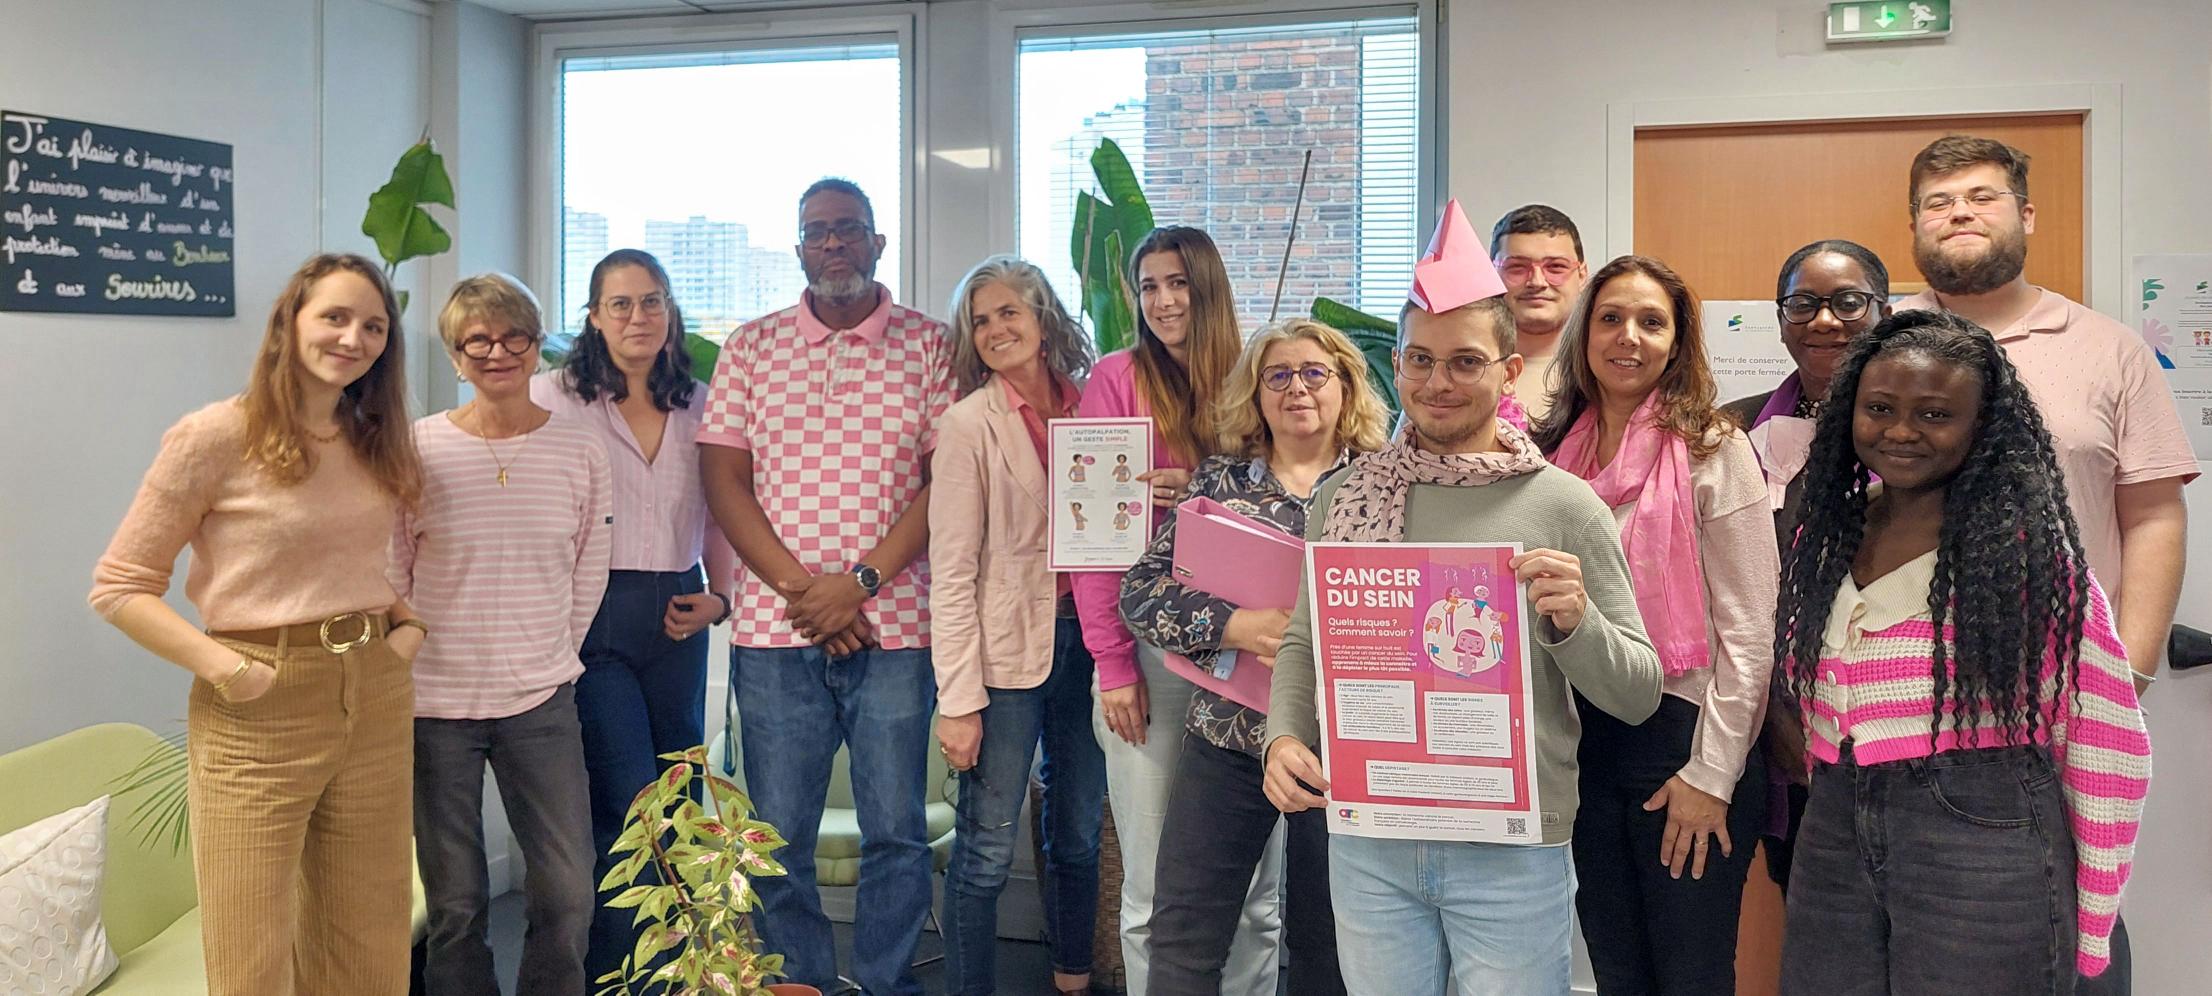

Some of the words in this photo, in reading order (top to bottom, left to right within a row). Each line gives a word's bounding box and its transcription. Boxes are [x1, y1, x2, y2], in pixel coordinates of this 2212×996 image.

[4, 115, 63, 158] J'ai
[4, 203, 58, 232] enfant
[2, 235, 80, 264] protection
[104, 273, 197, 301] Sourires
[1713, 356, 1735, 364] Merci
[1734, 369, 1756, 377] porte
[1325, 567, 1421, 586] CANCER
[1327, 589, 1358, 607] DU
[1363, 589, 1414, 608] SEIN
[1328, 617, 1354, 626] Quels
[1356, 618, 1390, 628] risques
[1392, 619, 1397, 627] ?
[1329, 628, 1376, 636] Comment
[1378, 629, 1407, 637] savoir
[1409, 629, 1414, 637] ?
